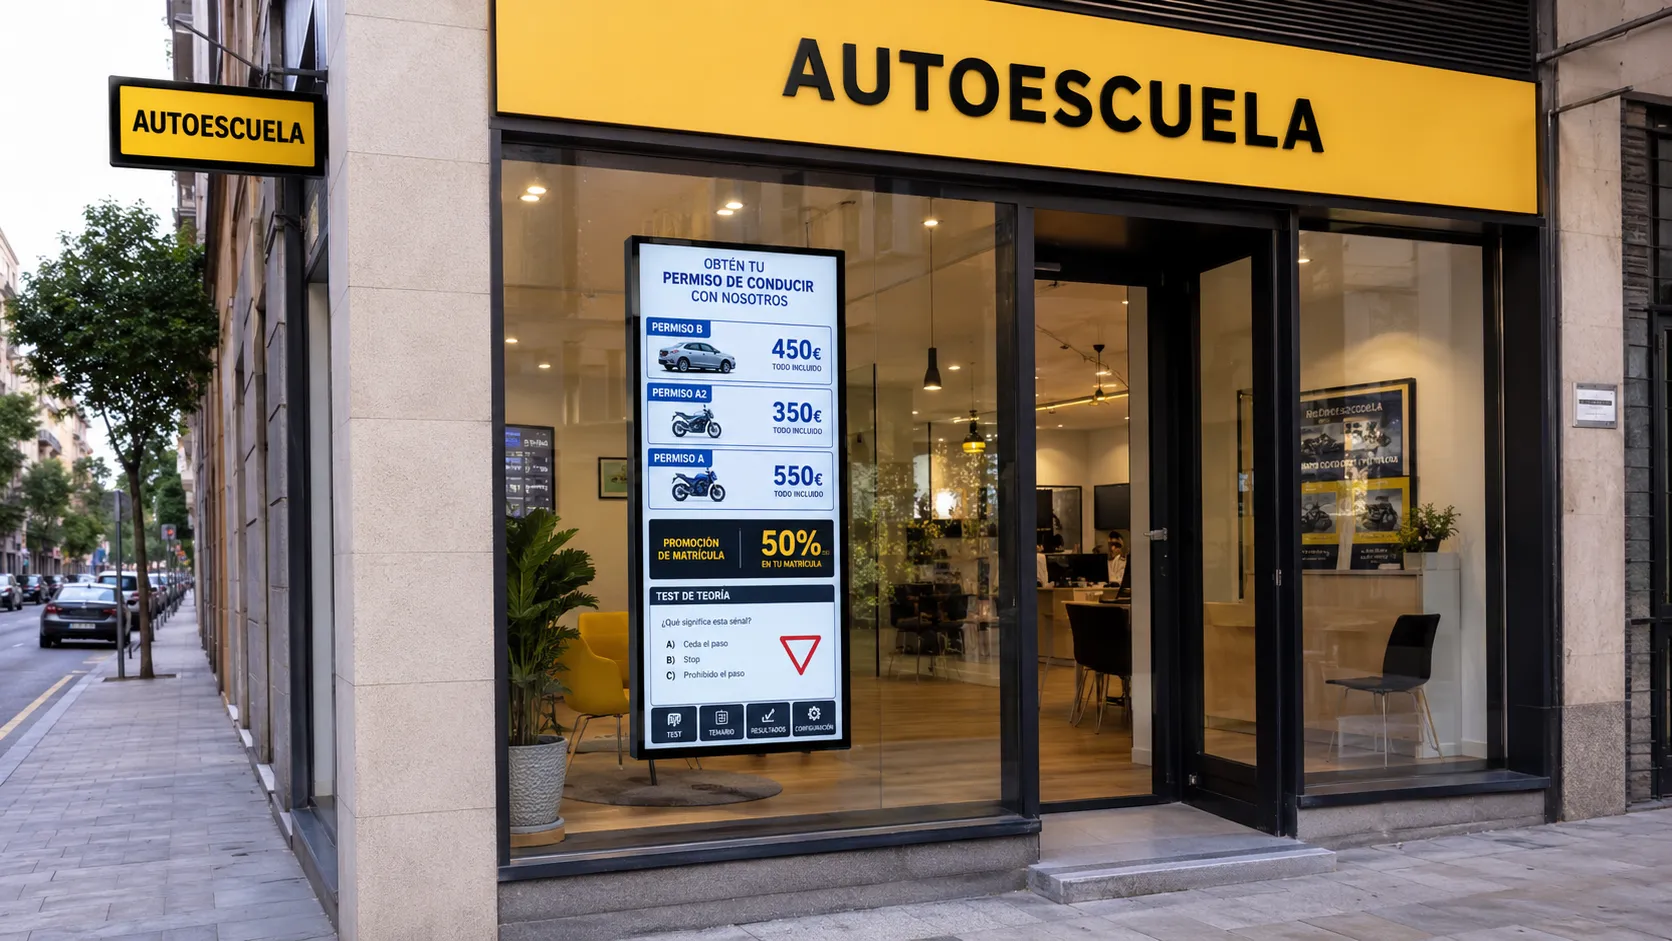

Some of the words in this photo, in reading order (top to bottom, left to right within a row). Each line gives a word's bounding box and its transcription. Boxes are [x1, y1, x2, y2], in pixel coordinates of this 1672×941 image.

[782, 37, 1325, 154] AUTOESCUELA
[132, 109, 305, 144] AUTOESCUELA
[704, 257, 745, 272] OBTÉN
[749, 261, 765, 273] TU
[663, 271, 722, 288] PERMISO
[727, 276, 743, 288] DE
[747, 277, 814, 292] CONDUCIR
[691, 290, 718, 303] CON
[722, 293, 788, 307] NOSOTROS
[652, 322, 694, 334] PERMISO
[697, 325, 703, 334] B
[771, 338, 822, 361] 450€
[772, 363, 791, 371] TODO
[792, 364, 822, 372] INCLUIDO
[652, 388, 693, 398] PERMISO
[695, 389, 707, 399] A2
[772, 401, 822, 423] 350€
[792, 427, 823, 435] INCLUIDO
[654, 454, 695, 463] PERMISO
[698, 454, 704, 463] A
[773, 465, 823, 486] 550€
[774, 490, 792, 498] TODO
[663, 537, 719, 548] PROMOCIÓN
[761, 529, 822, 557] 50%
[658, 551, 670, 560] DE
[672, 549, 725, 561] MATRÍCULA
[761, 560, 772, 568] EN
[773, 560, 783, 568] TU
[656, 592, 679, 601] TEST
[682, 592, 695, 601] DE
[697, 589, 730, 601] TEORÍA
[666, 640, 675, 649] A)
[683, 640, 701, 648] Ceda
[703, 639, 709, 647] el
[711, 640, 728, 649] paso
[666, 655, 675, 665] B)
[683, 655, 700, 664] Stop
[666, 671, 675, 681] C)
[683, 671, 718, 679] Prohibido
[720, 670, 726, 678] el
[728, 671, 745, 679] paso
[667, 730, 682, 738] TEST
